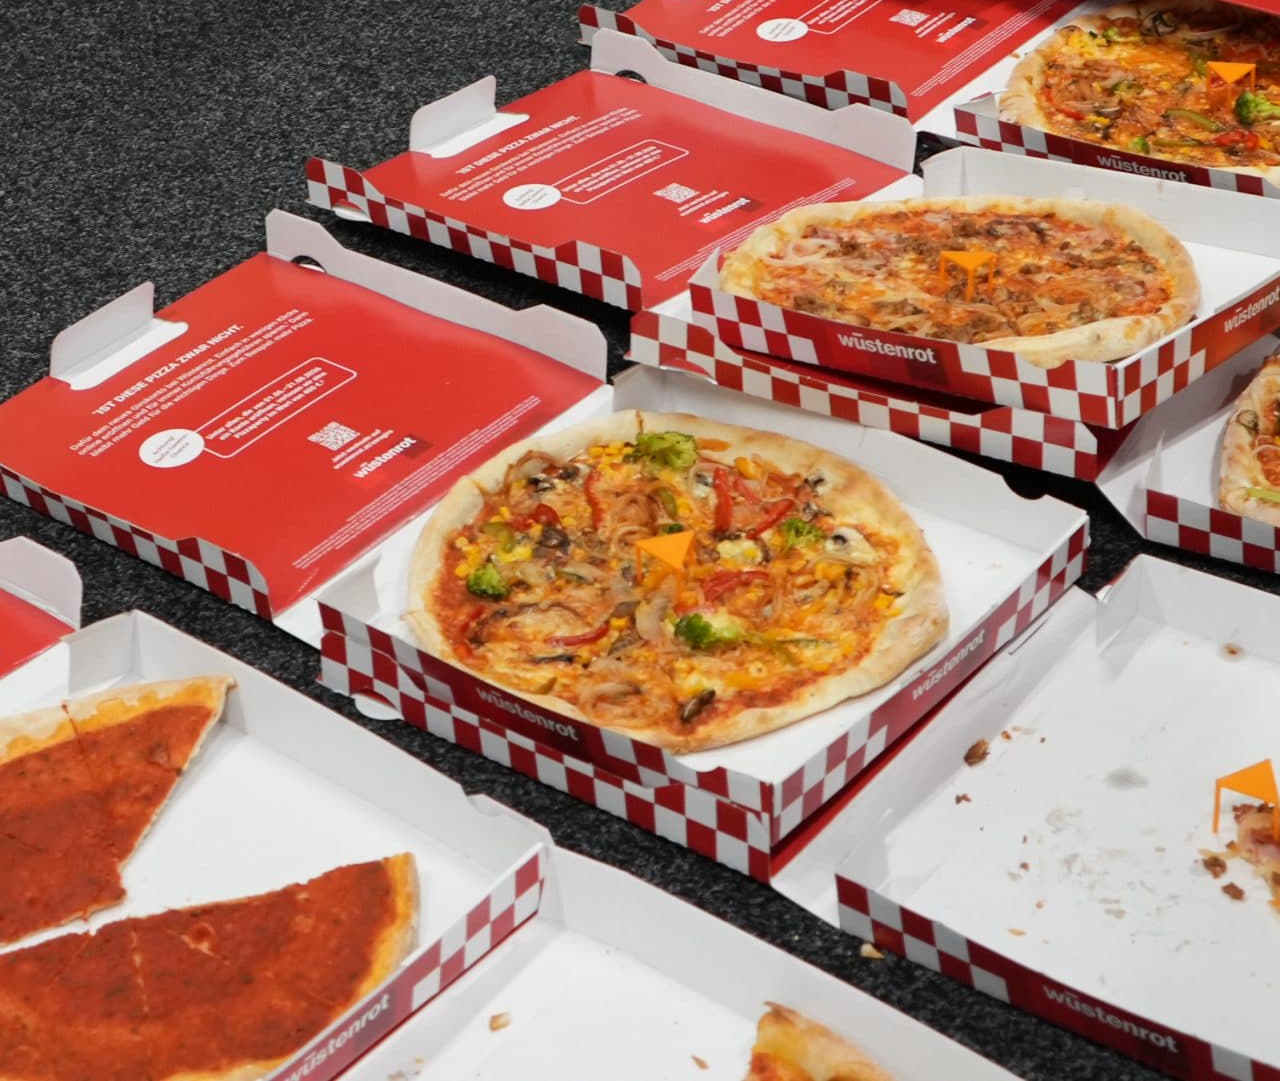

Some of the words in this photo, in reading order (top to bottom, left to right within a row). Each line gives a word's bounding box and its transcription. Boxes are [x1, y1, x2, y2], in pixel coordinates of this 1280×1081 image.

[499, 140, 528, 153] PIZZA
[114, 382, 148, 402] DIESE
[145, 363, 180, 382] PIZZA
[176, 344, 210, 363] ZWAR
[207, 325, 243, 344] NICHT.
